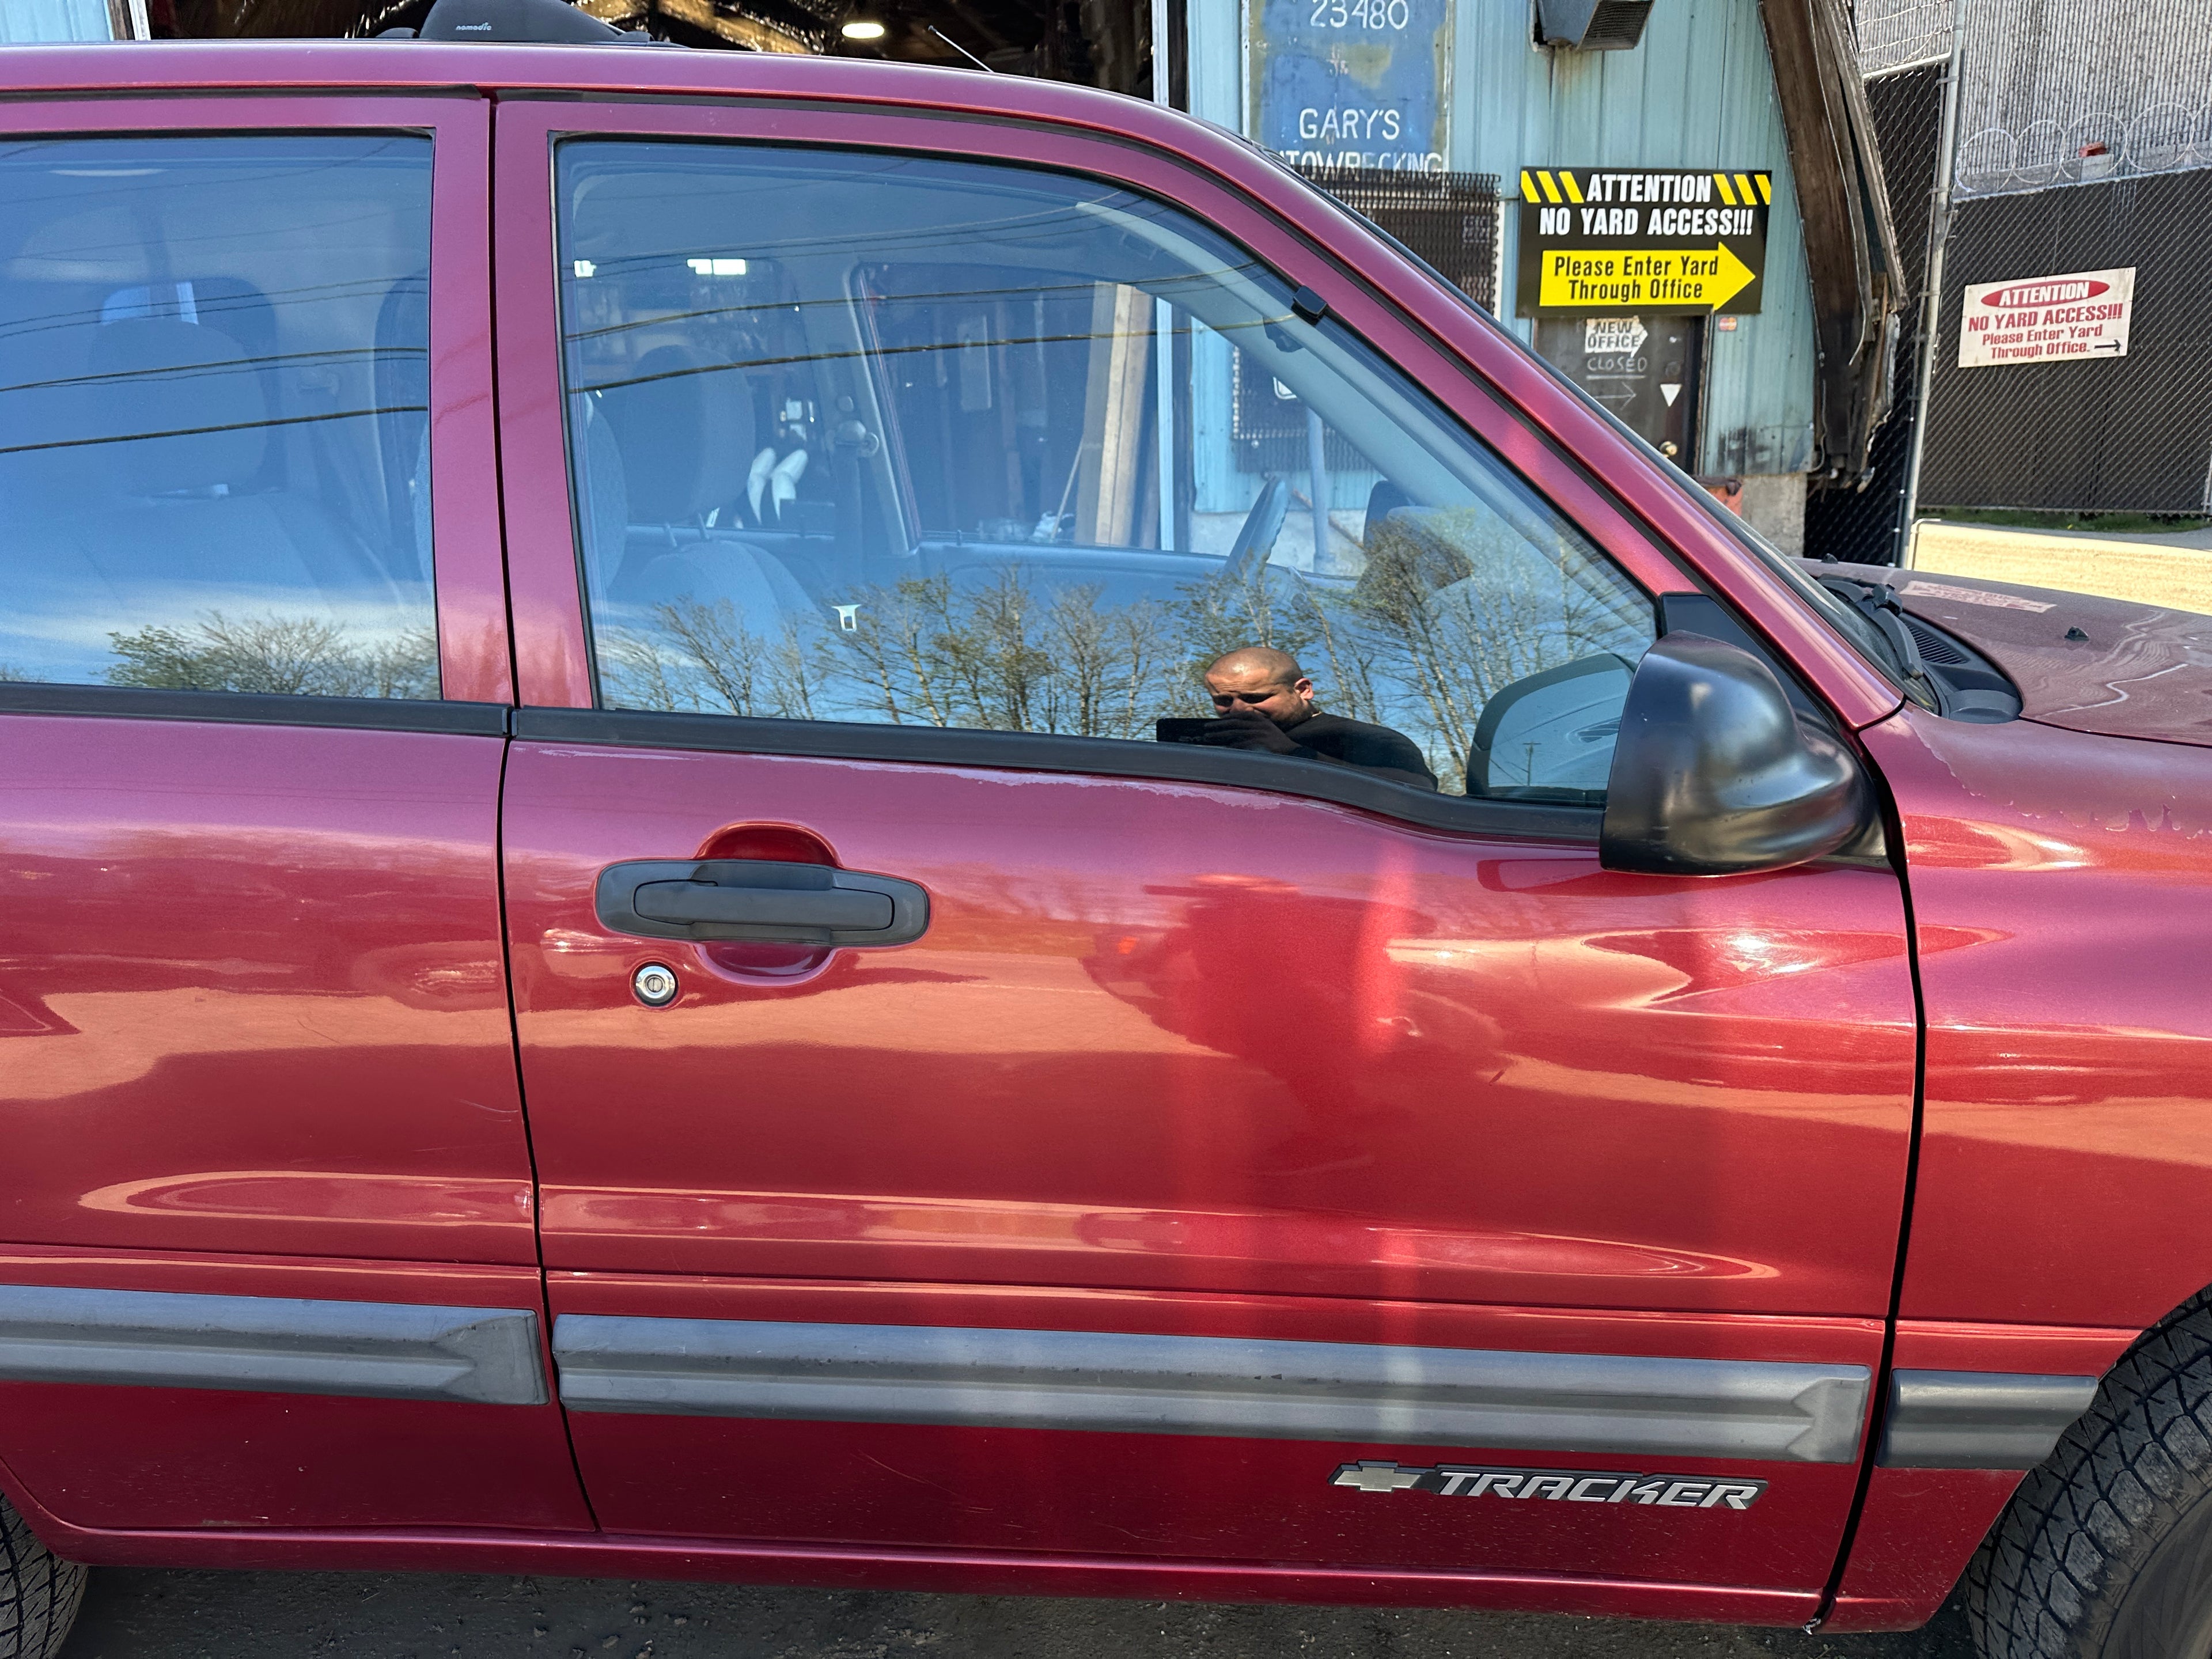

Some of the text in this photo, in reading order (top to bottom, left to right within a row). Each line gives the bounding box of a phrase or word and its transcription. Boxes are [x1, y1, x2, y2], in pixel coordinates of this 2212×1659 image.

[1310, 0, 1409, 29] 23480
[1299, 108, 1400, 140] GARY'S
[1586, 174, 1712, 202] ATTENTION
[1539, 207, 1753, 236] NO YARD ACCESS!!!
[1555, 255, 1719, 276] Please Enter Yard
[1569, 279, 1703, 302] Through Office
[1999, 282, 2090, 306] ATTENTION
[1594, 321, 1632, 334] NEW
[1968, 303, 2123, 332] NO YARD ACCESS!!!
[1588, 334, 1641, 349] OFFICE
[1982, 324, 2103, 345] Please Enter Yard
[1991, 342, 2090, 359] Through Office.
[1587, 356, 1647, 372] CLOSED
[1439, 1471, 1759, 1510] TRACKER
